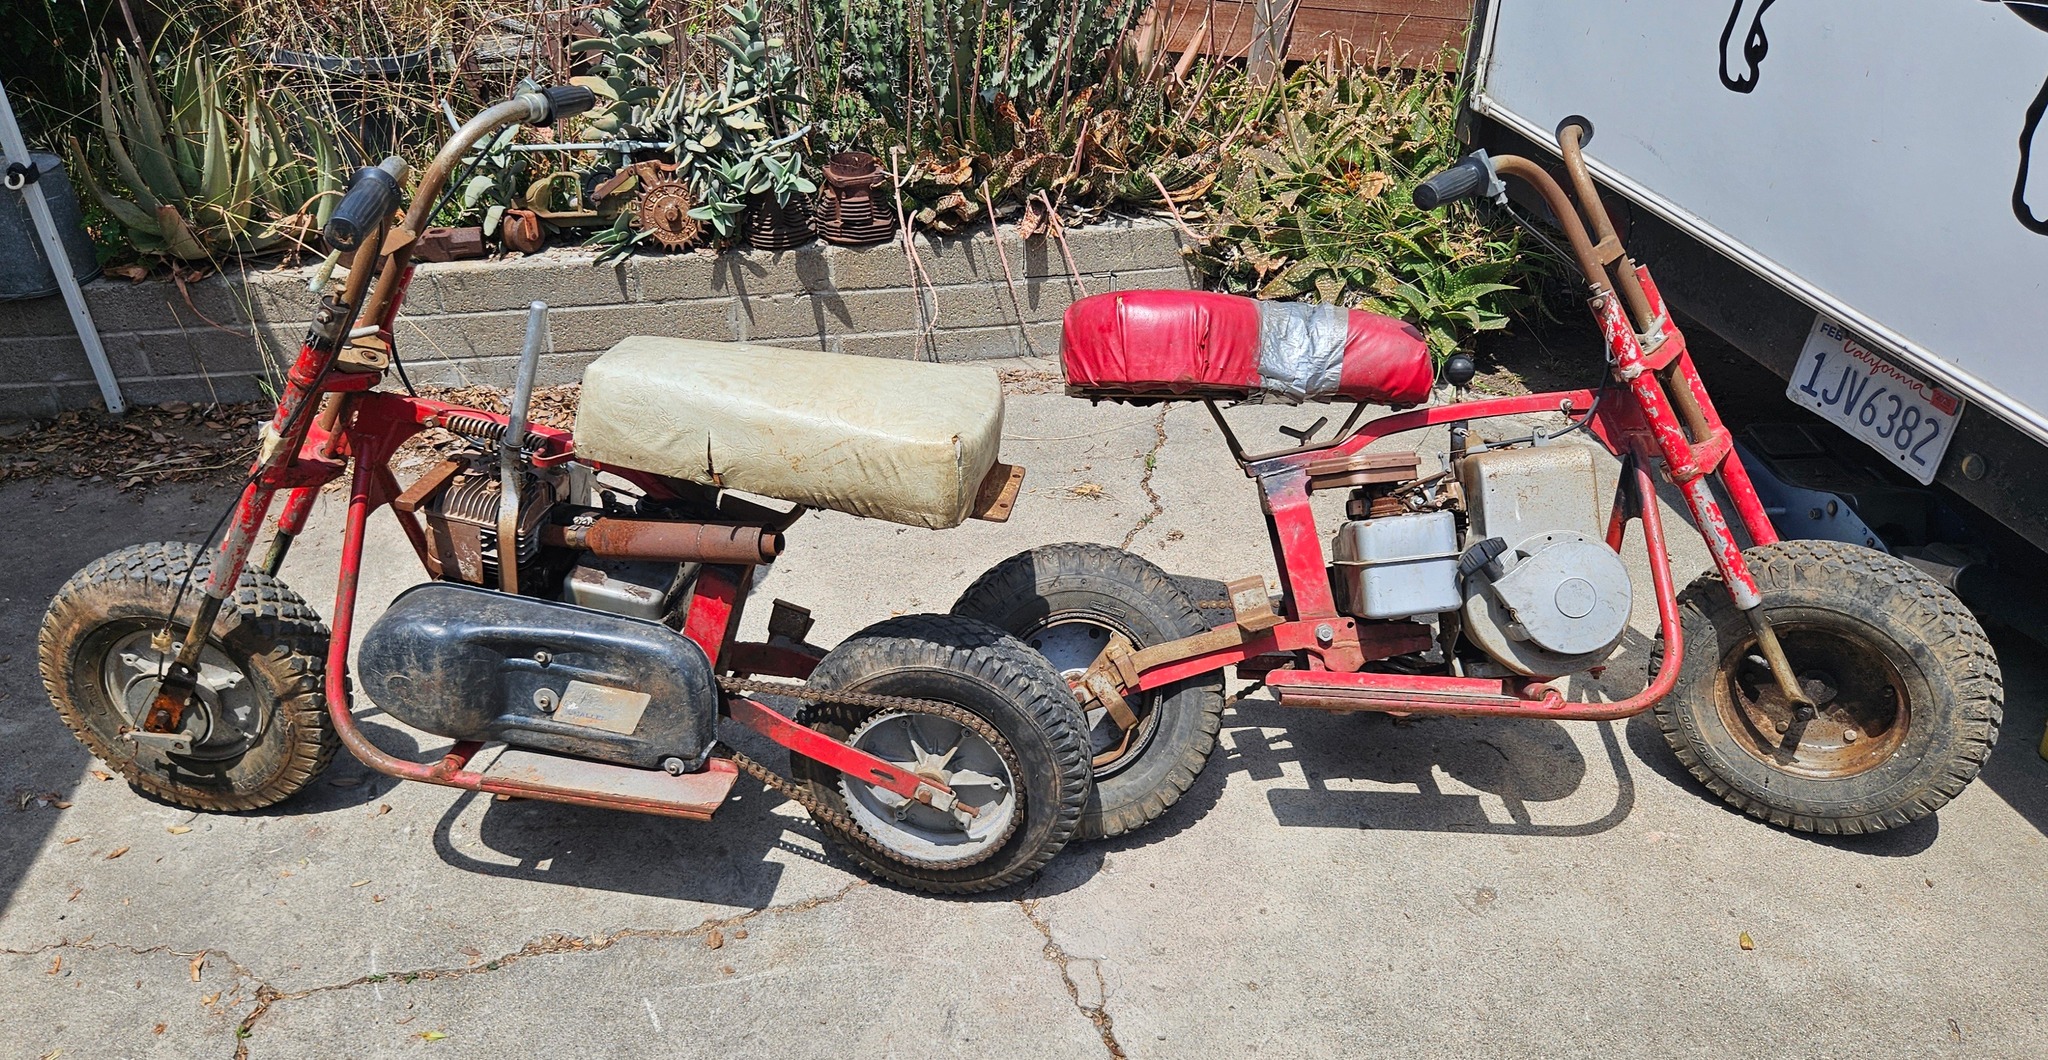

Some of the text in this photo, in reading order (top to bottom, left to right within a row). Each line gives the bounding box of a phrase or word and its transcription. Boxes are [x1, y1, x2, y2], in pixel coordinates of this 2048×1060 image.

[1820, 322, 1842, 341] FEB
[1844, 339, 1930, 401] California
[1801, 352, 1939, 466] 1JV6382
